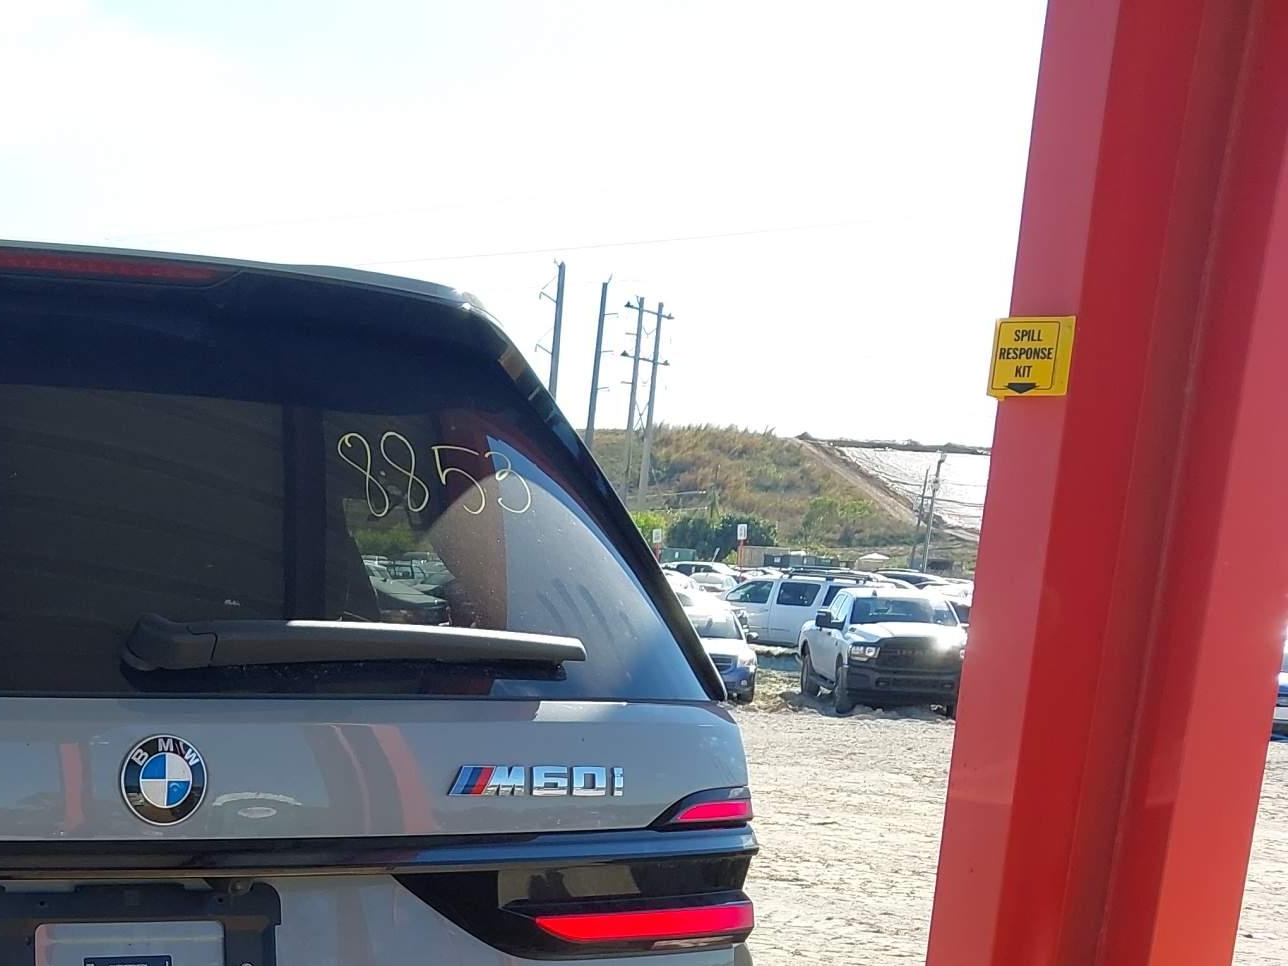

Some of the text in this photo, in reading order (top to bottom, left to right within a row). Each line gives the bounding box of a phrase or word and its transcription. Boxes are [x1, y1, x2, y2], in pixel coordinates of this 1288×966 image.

[1013, 329, 1043, 342] SPILL
[998, 347, 1054, 360] RESPONSE
[1014, 365, 1033, 378] KIT
[337, 430, 532, 518] 8853
[131, 737, 201, 767] BMW
